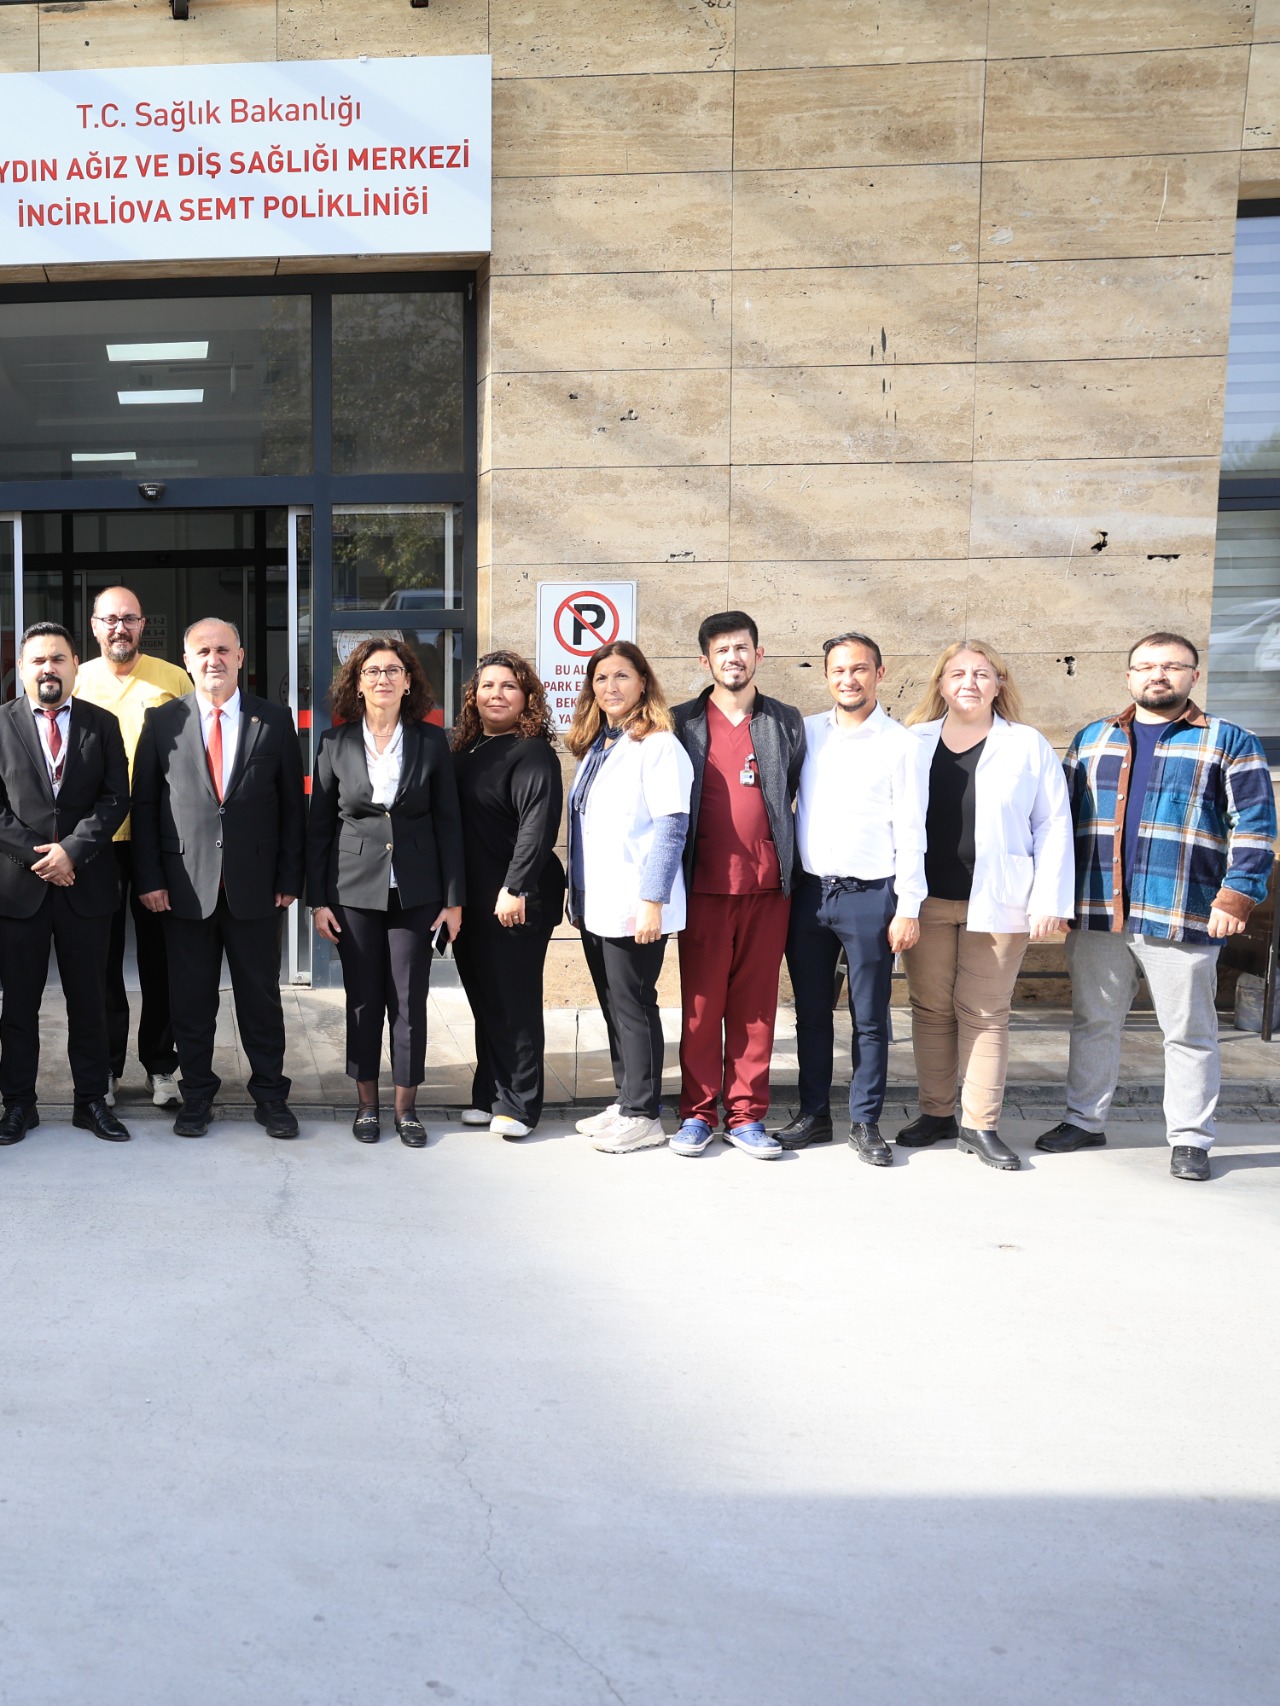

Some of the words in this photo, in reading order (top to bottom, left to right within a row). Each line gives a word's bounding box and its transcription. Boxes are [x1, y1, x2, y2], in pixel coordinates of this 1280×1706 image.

[77, 103, 126, 128] T.C.
[135, 100, 221, 133] Sağlık
[231, 95, 362, 127] Bakanlığı
[66, 151, 128, 181] AĞIZ
[135, 153, 169, 177] VE
[178, 147, 222, 179] DİŞ
[230, 145, 338, 175] SAĞLIĞI
[348, 139, 470, 171] MERKEZİ
[18, 195, 172, 227] İNCİRLİOVA
[179, 197, 255, 222] SEMT
[263, 186, 429, 219] POLİKLİNİĞİ
[543, 681, 572, 692] PARK
[555, 664, 570, 675] BU
